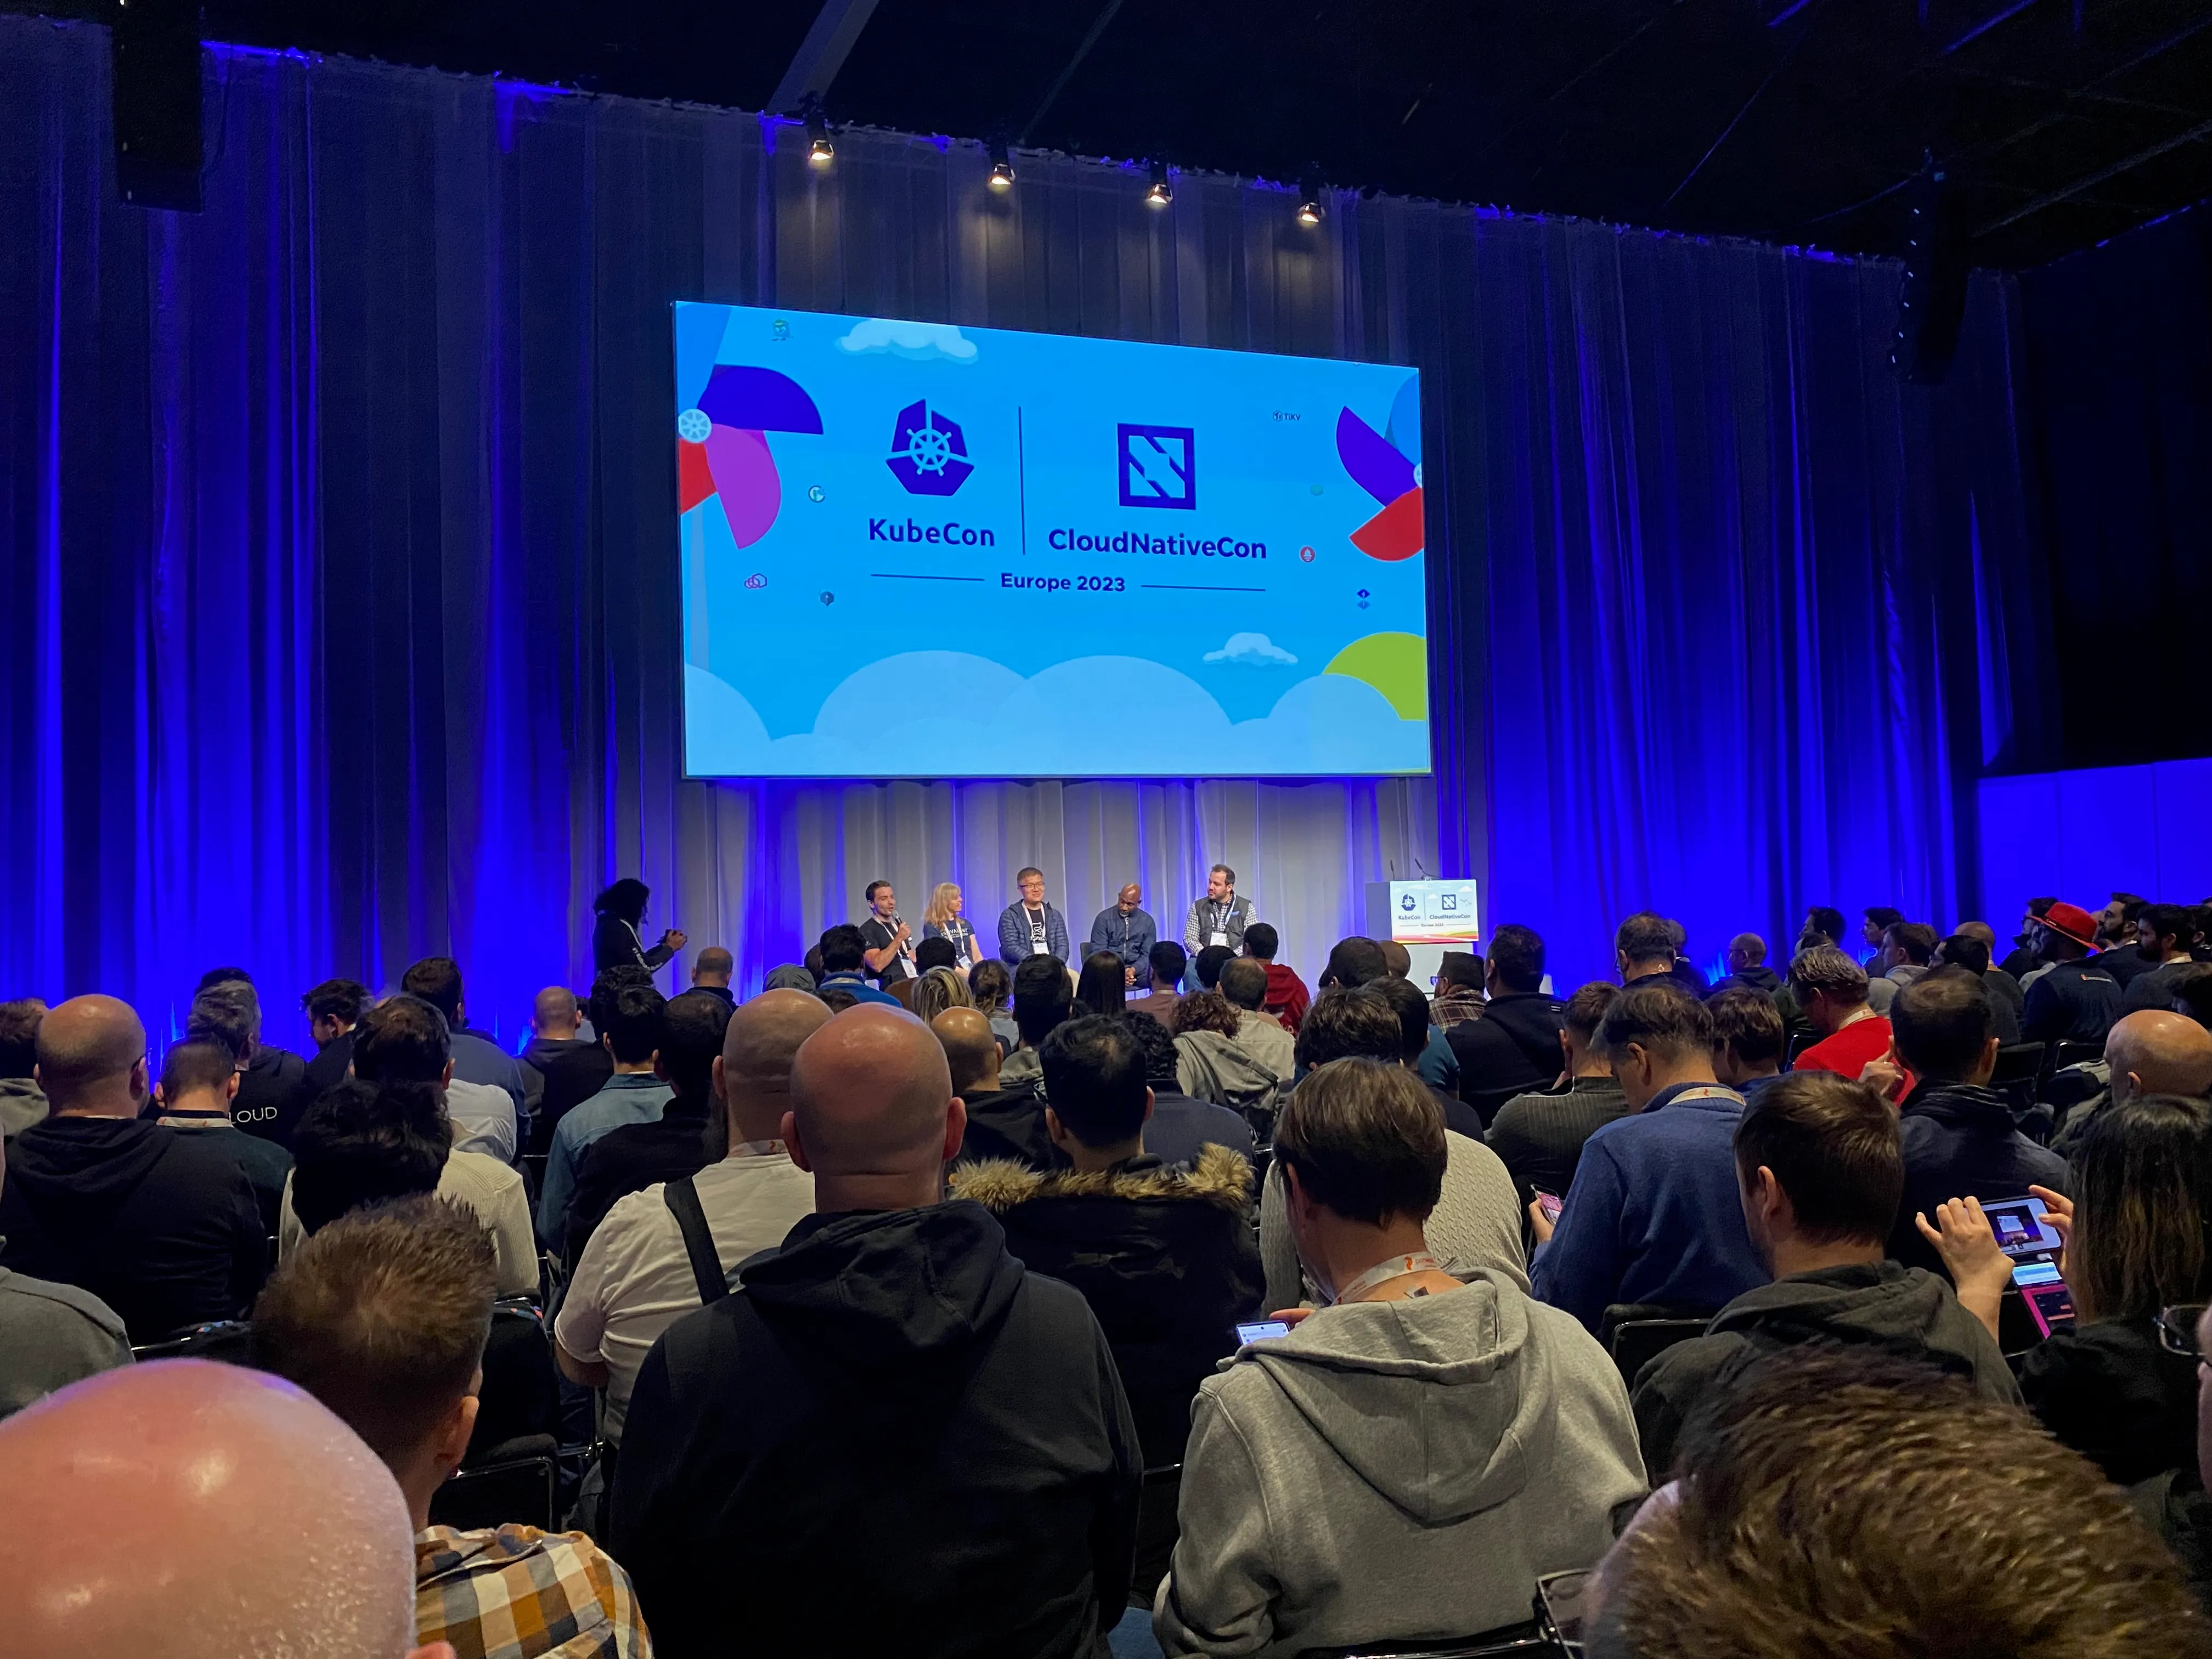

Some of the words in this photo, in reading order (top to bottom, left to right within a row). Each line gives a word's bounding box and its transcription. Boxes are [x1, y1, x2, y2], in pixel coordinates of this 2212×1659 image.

[868, 517, 995, 548] KubeCon
[1048, 527, 1267, 559] CloudNativeCon
[1000, 572, 1072, 592] Europe
[1077, 575, 1126, 592] 2023
